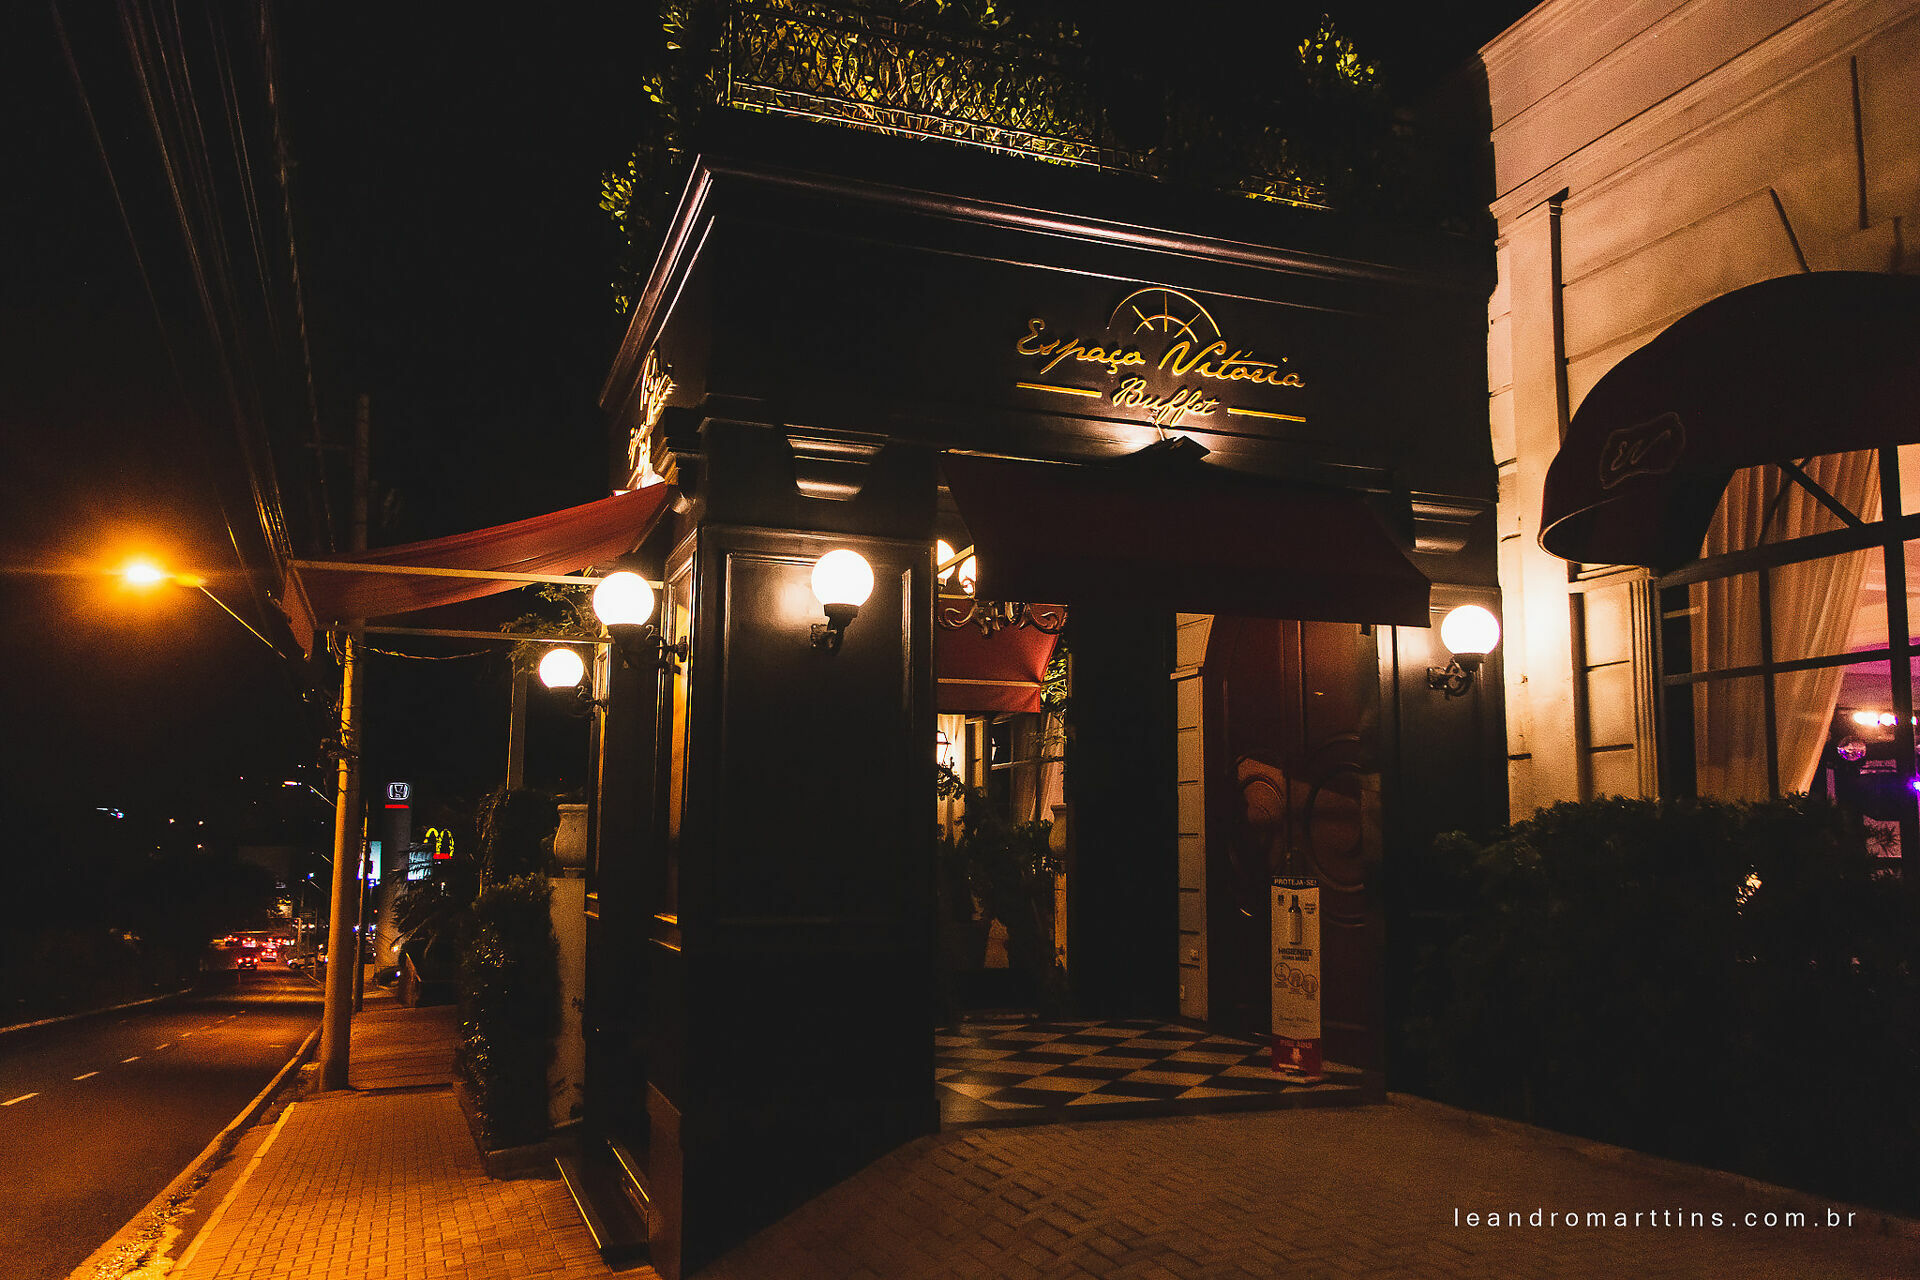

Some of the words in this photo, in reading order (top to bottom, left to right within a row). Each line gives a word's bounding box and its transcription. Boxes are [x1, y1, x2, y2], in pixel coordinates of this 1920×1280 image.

[1017, 317, 1147, 375] Espaço
[1158, 340, 1306, 388] Vitória
[1112, 376, 1221, 428] Buffet
